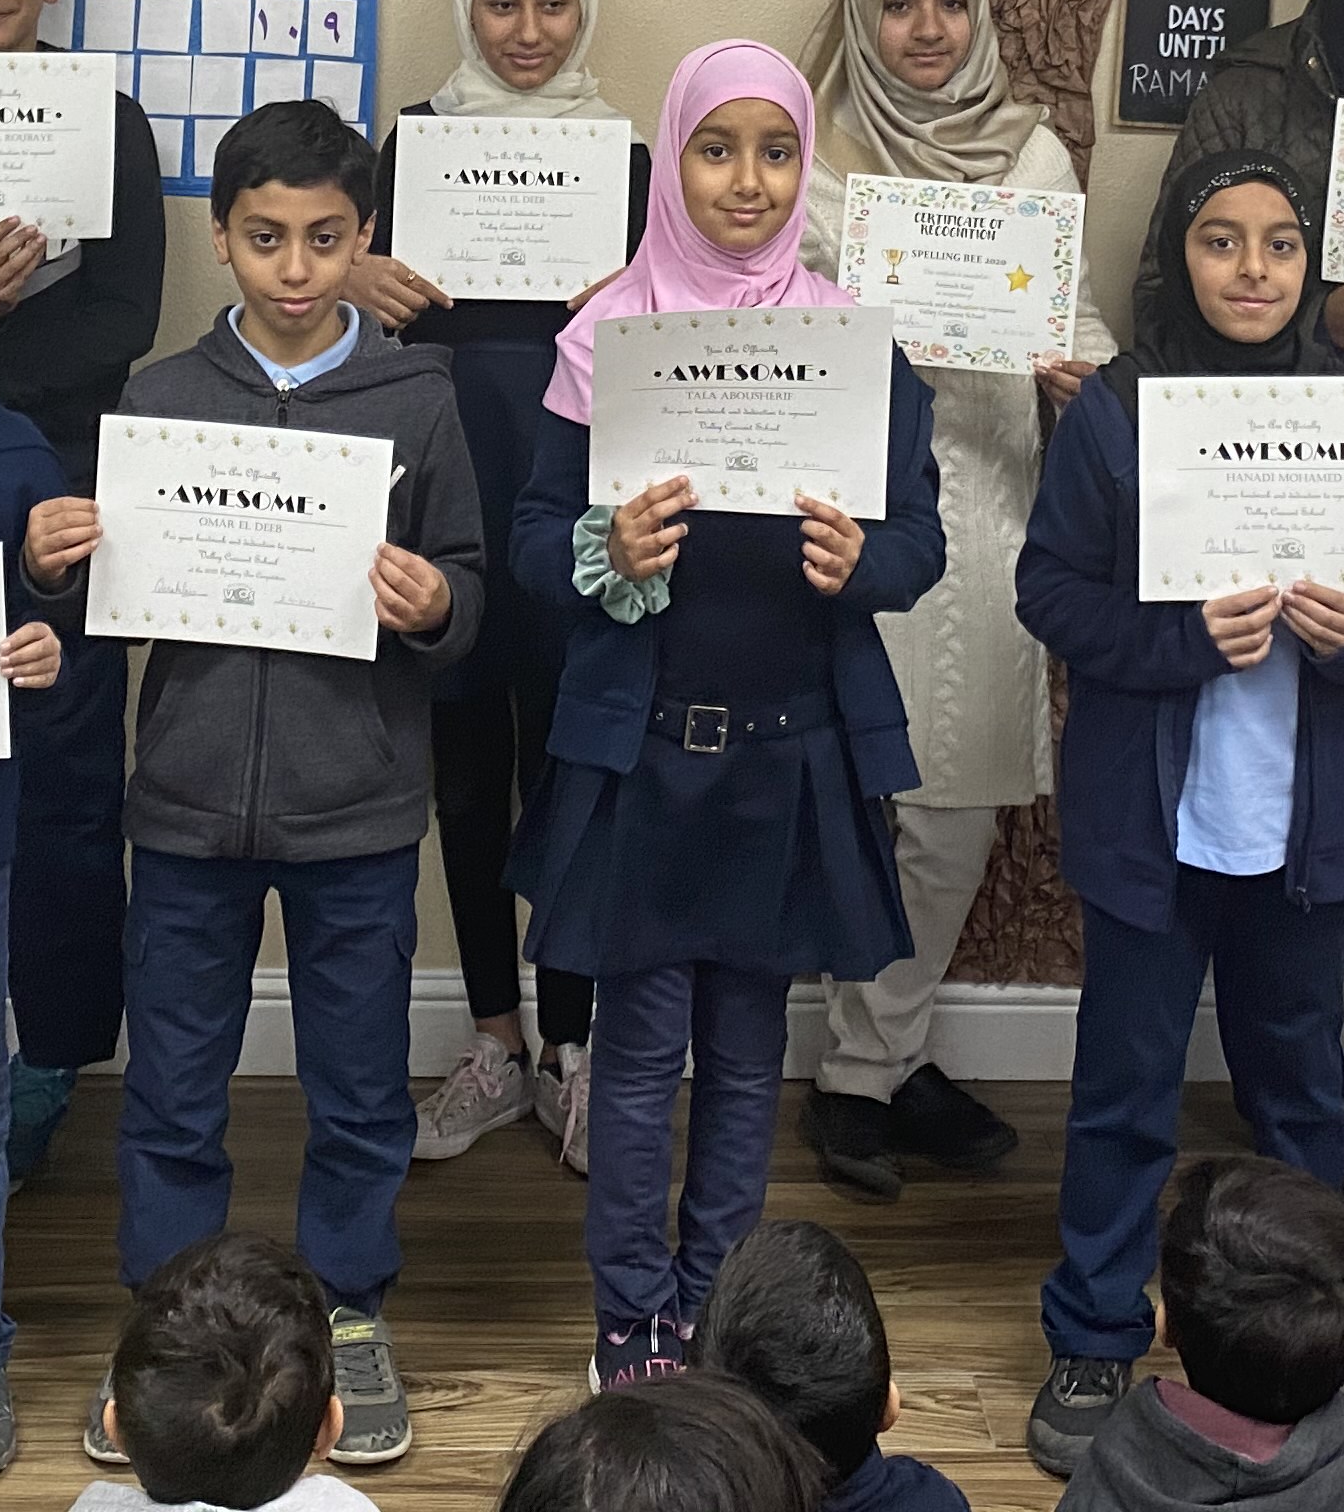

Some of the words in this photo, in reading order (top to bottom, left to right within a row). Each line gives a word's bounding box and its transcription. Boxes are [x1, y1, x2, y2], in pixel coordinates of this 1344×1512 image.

[1168, 4, 1226, 31] DAYS
[323, 10, 341, 43] ٩
[453, 169, 570, 187] AWESOME
[914, 212, 986, 229] CERTIFICATE
[990, 217, 1005, 229] OF
[920, 224, 996, 241] RECOGNITION
[911, 249, 961, 262] SPELLING
[964, 254, 982, 263] BEE
[666, 363, 814, 382] AWESOME
[685, 391, 717, 401] TALA
[721, 391, 794, 401] ABOUSHERIF
[1226, 472, 1275, 483] HANADI
[1278, 472, 1342, 483] MOHAMED
[169, 484, 314, 515] AWESOME
[199, 517, 235, 530] OMAR
[239, 520, 251, 531] EL
